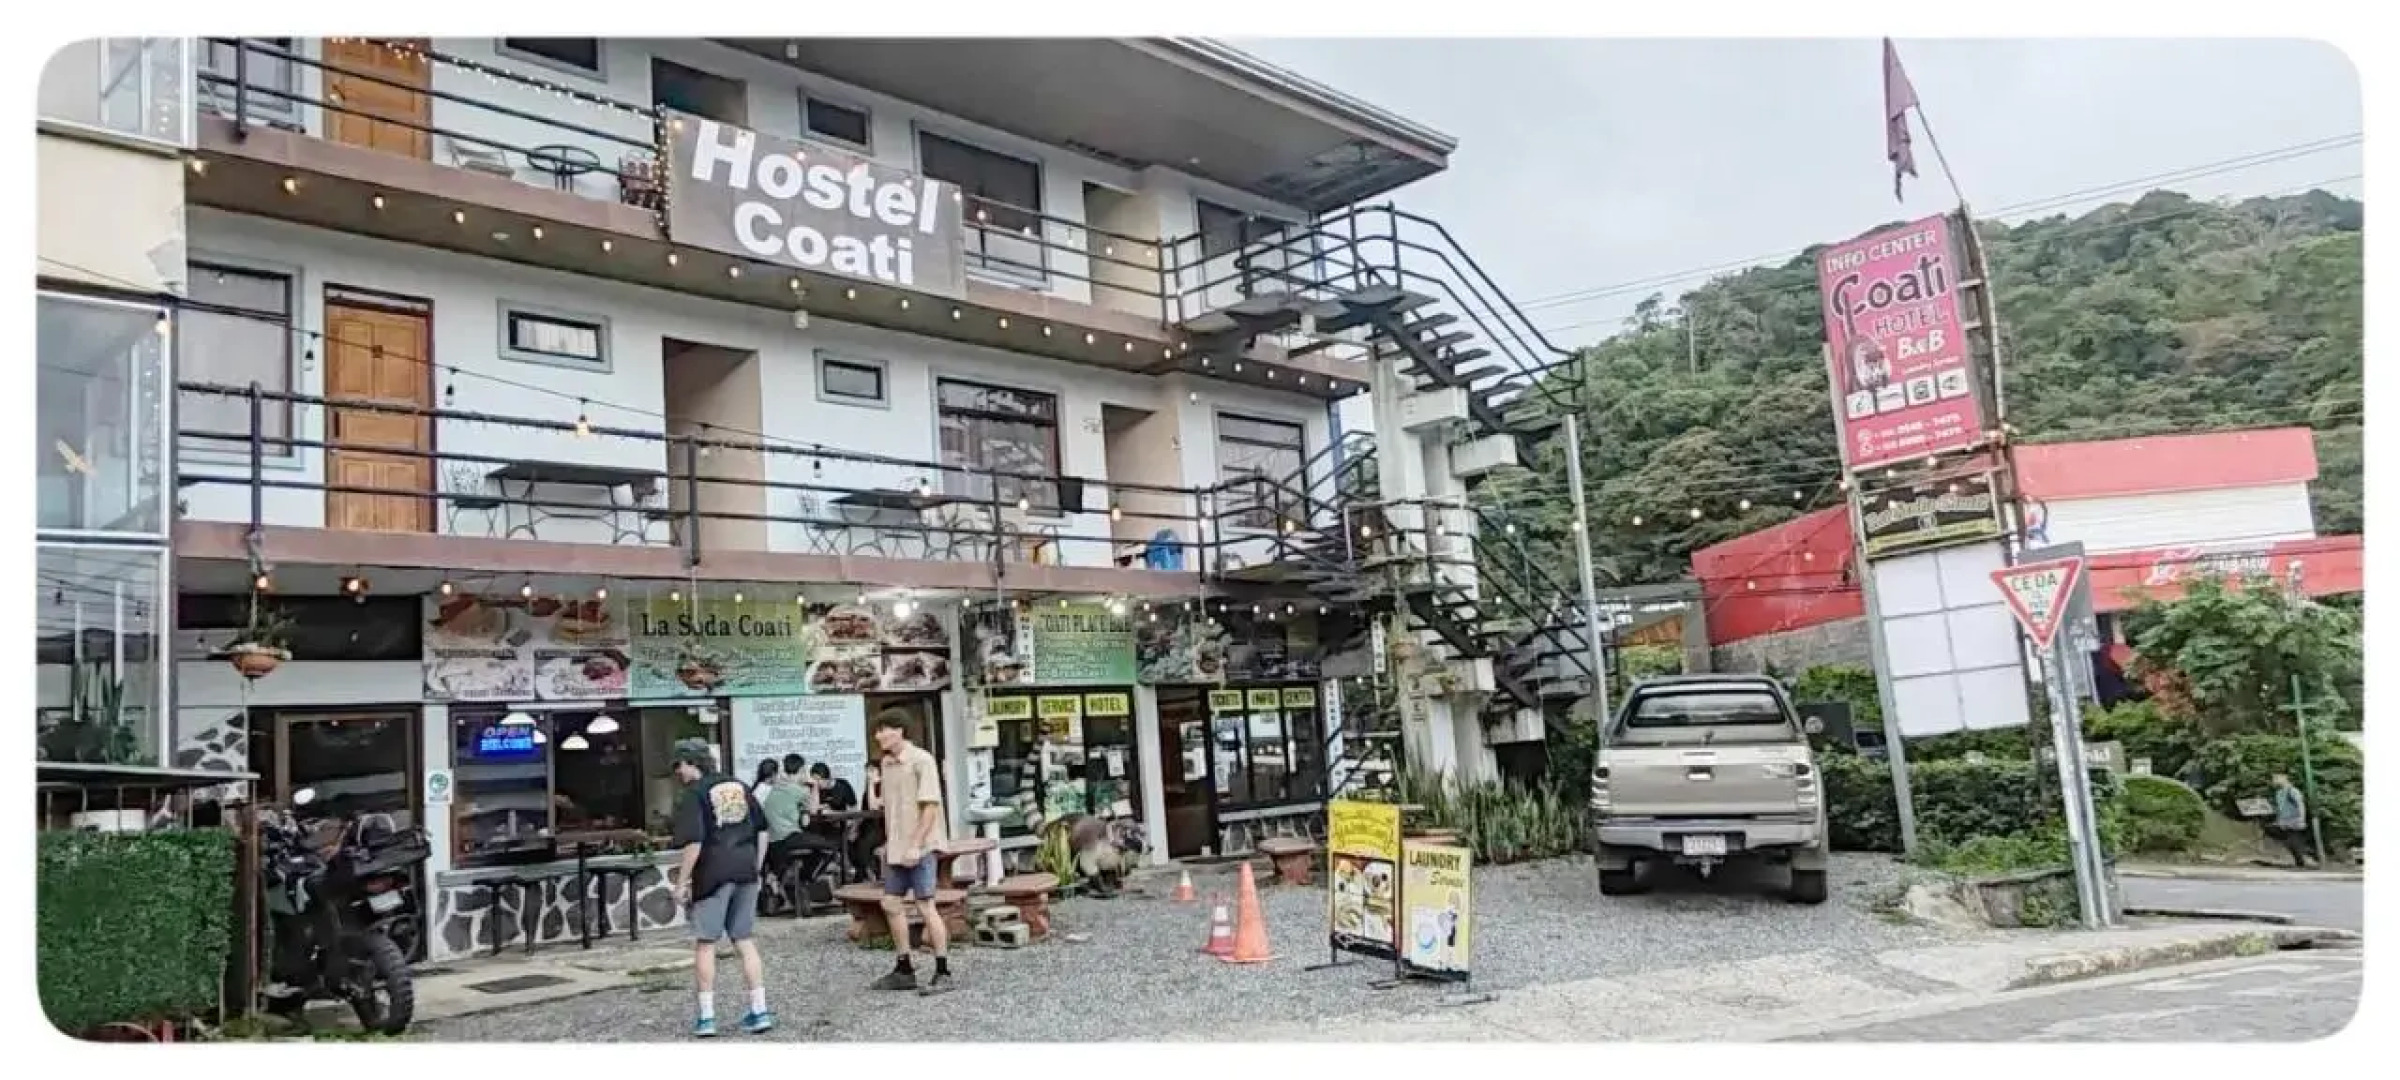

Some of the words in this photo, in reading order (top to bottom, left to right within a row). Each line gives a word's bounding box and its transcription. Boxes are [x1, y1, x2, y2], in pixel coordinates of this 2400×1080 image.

[692, 119, 940, 234] Hostel
[734, 201, 913, 285] Coati
[1827, 252, 1865, 274] INFO
[1869, 230, 1937, 261] CENTER
[1831, 255, 1947, 318] Coati
[1873, 304, 1949, 336] HOTEL
[2012, 572, 2058, 592] CEDA
[642, 613, 669, 637] La
[738, 614, 792, 637] Coati
[1088, 696, 1124, 712] HOTEL
[483, 725, 531, 738] OPEN
[1409, 850, 1461, 871] LAUNDRY
